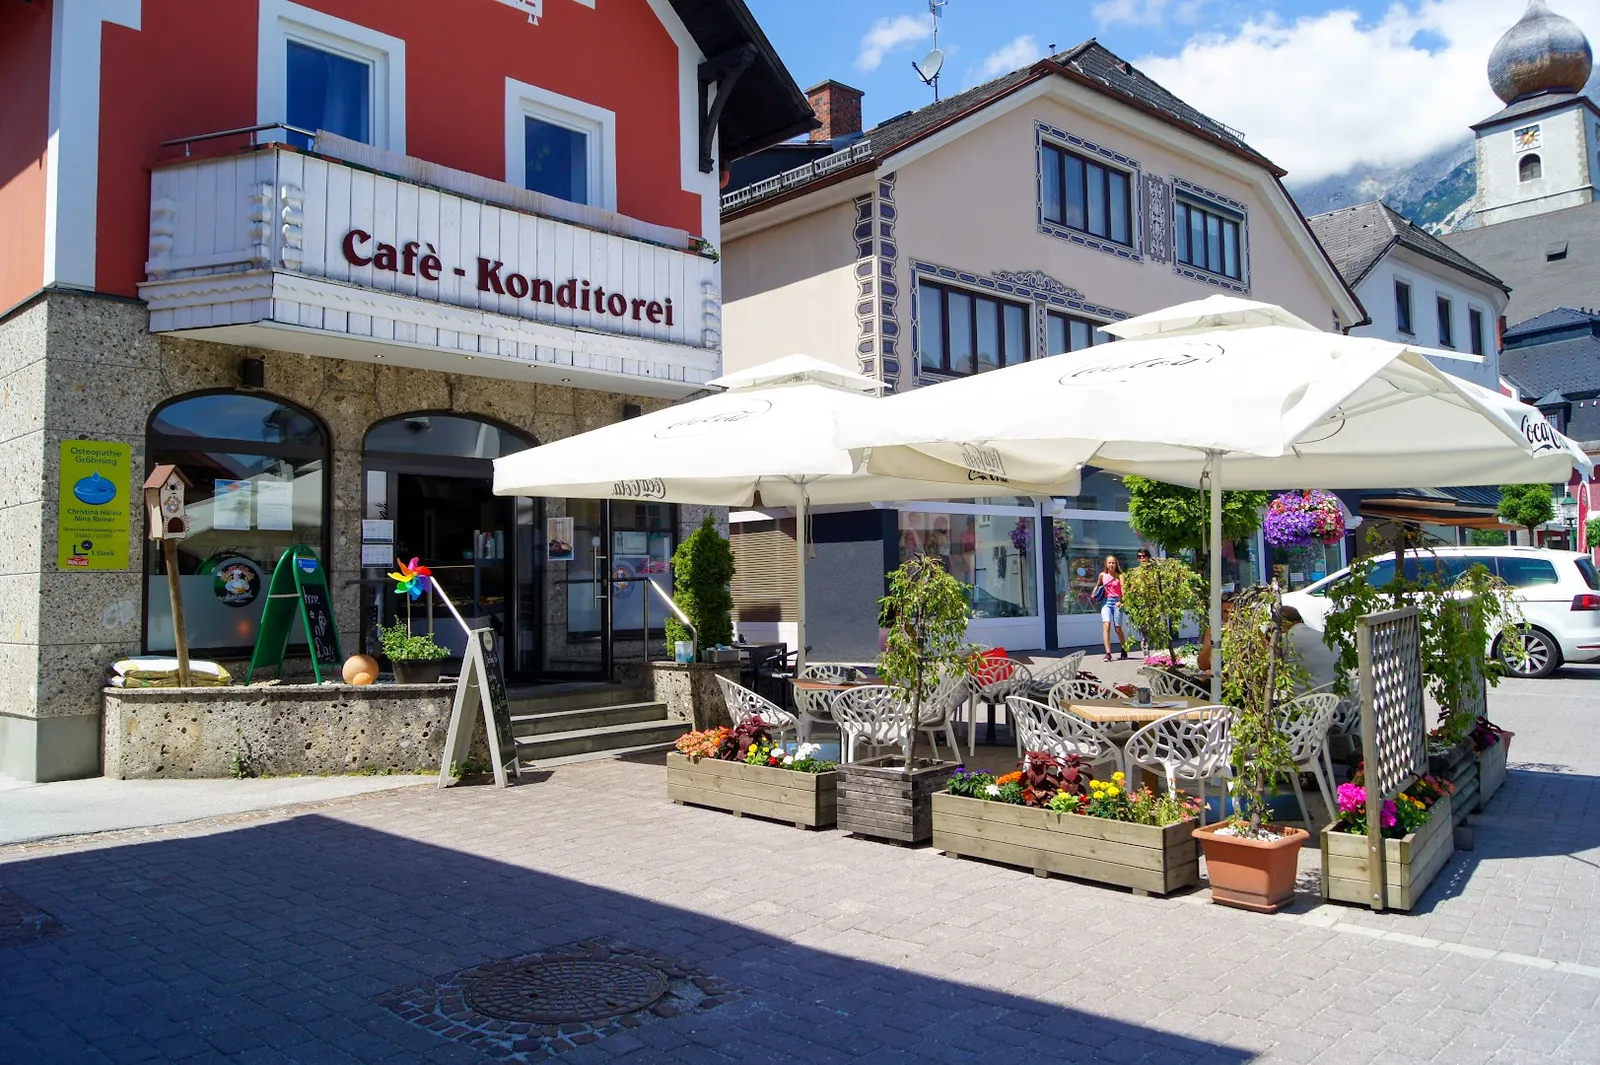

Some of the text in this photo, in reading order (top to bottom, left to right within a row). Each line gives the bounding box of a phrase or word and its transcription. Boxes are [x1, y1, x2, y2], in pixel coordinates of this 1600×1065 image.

[342, 229, 443, 281] Cafè
[477, 257, 674, 326] Konditorei
[70, 446, 122, 458] Osteopathie
[75, 455, 117, 466] Gröbming
[314, 637, 335, 663] Day
